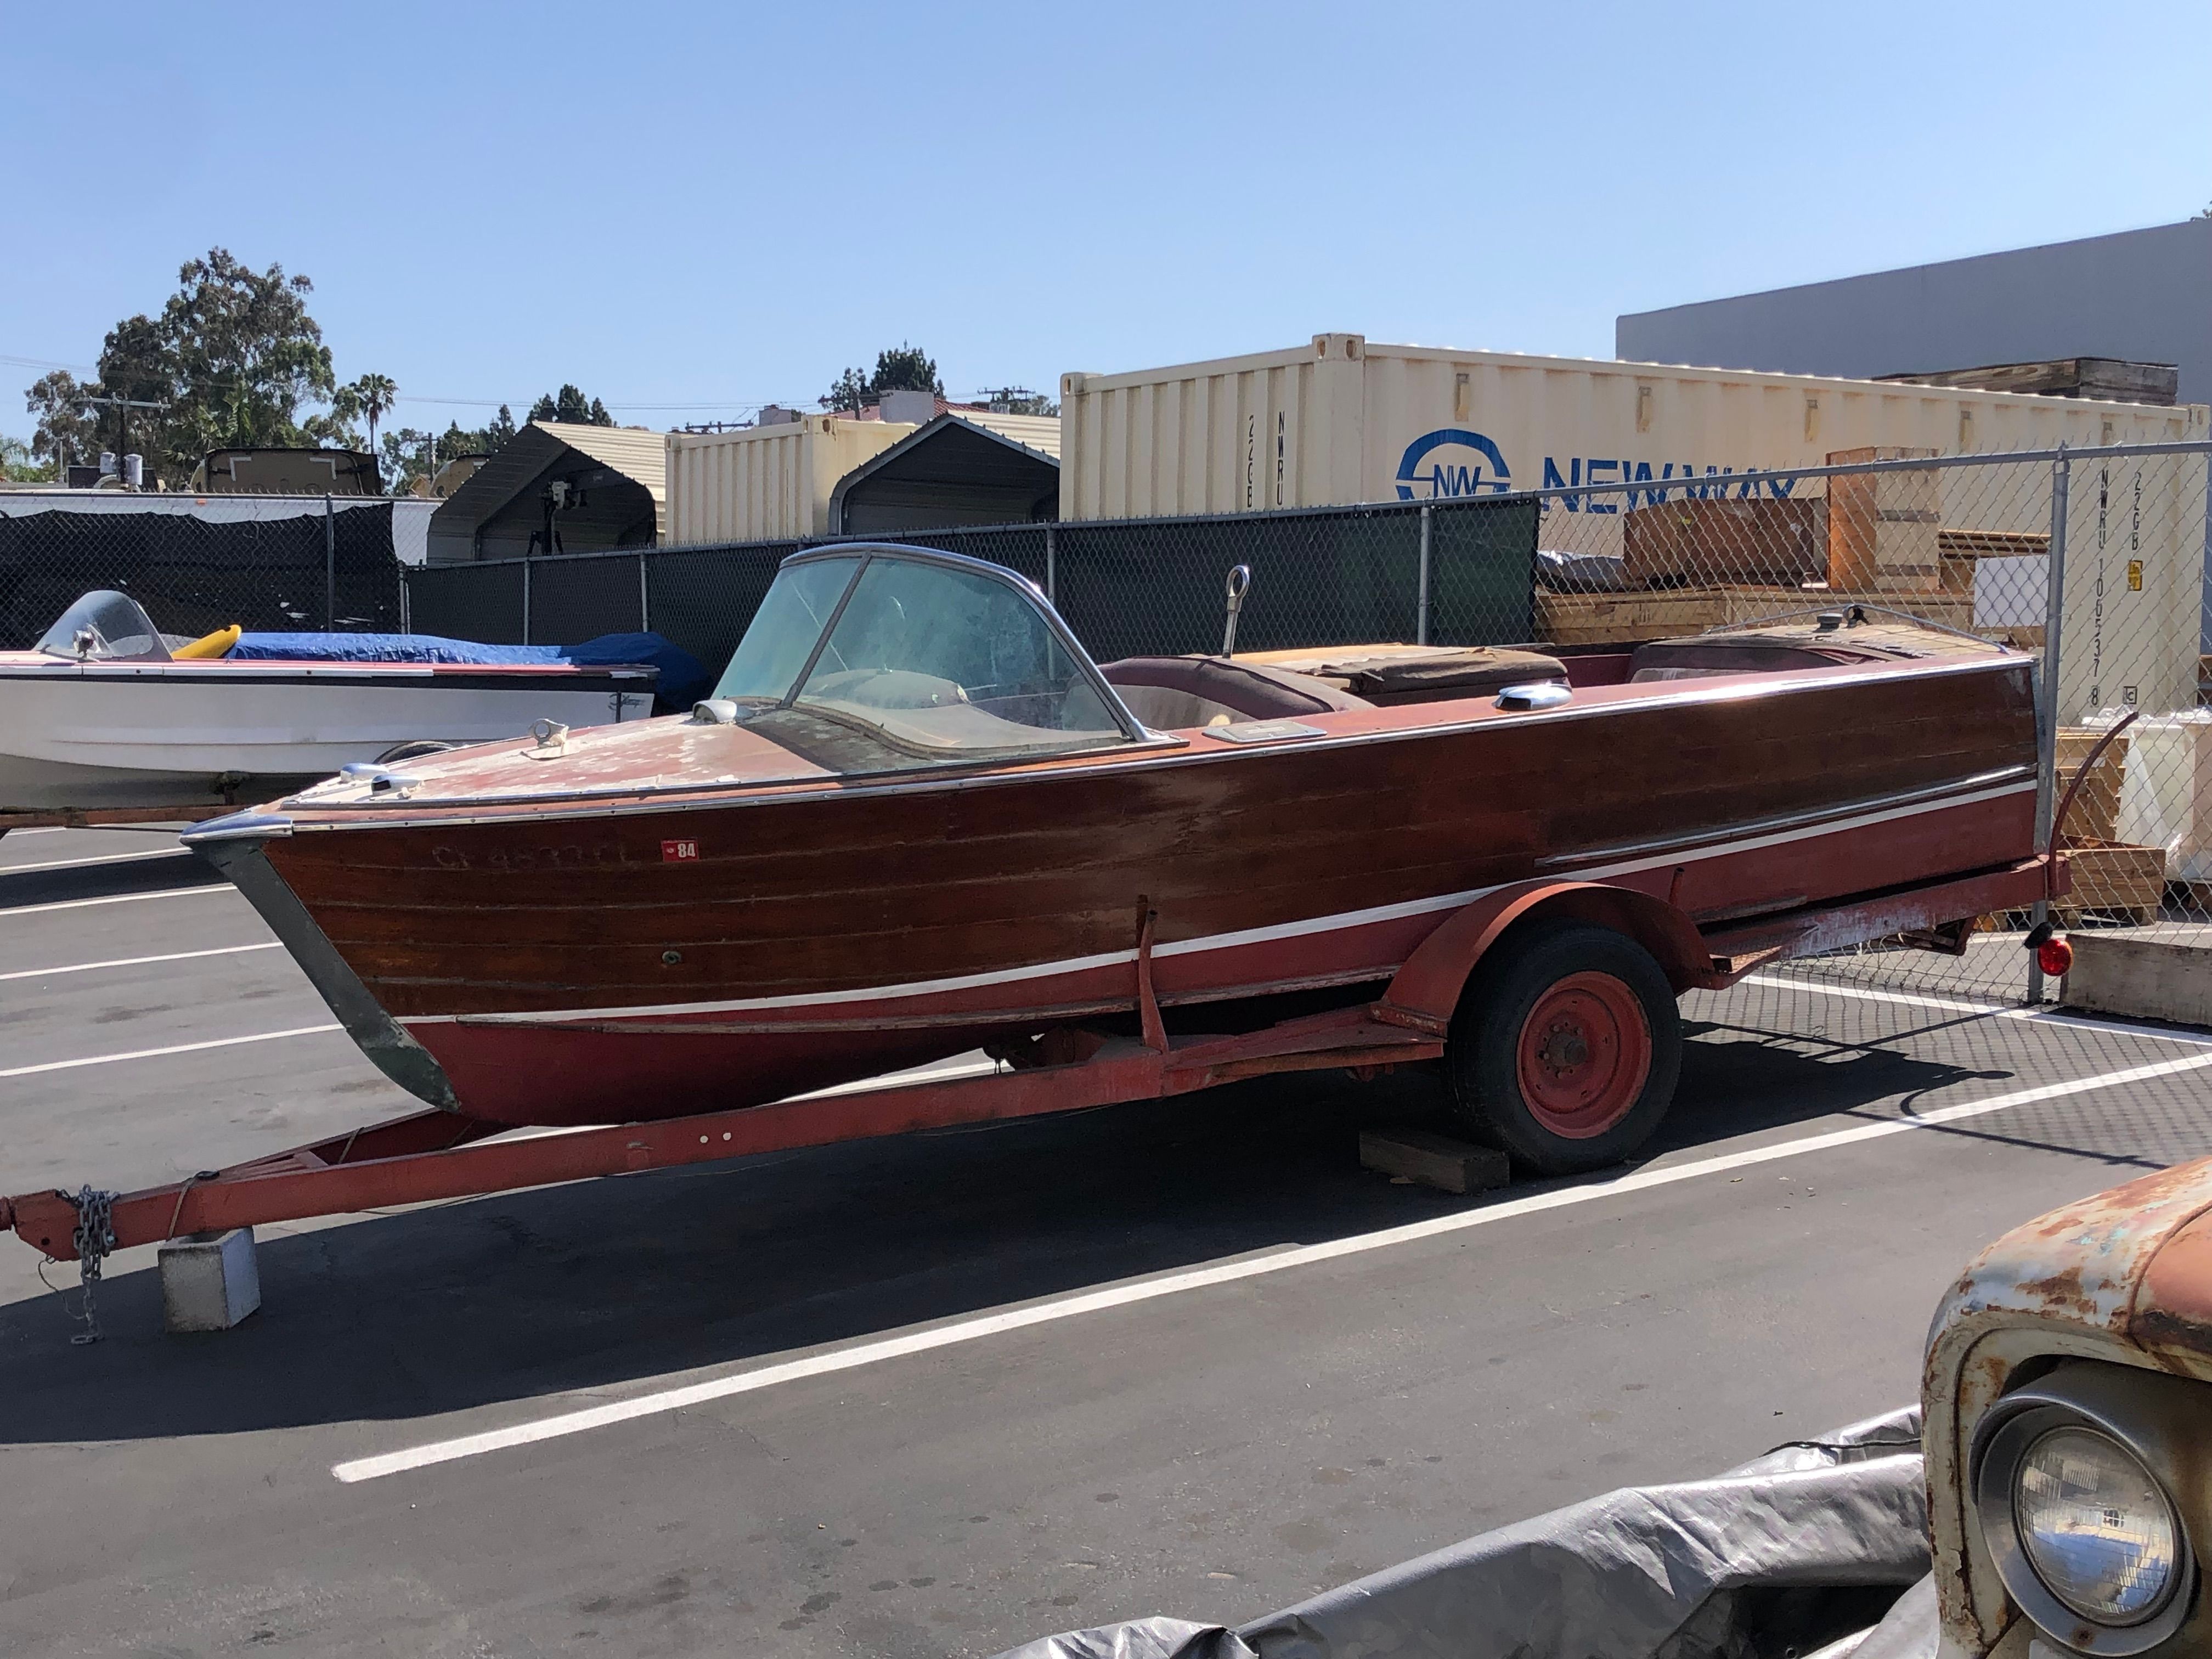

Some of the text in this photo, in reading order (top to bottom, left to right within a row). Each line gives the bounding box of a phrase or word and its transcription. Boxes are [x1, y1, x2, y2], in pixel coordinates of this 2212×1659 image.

[1277, 410, 1285, 506] NWRU
[1434, 464, 1482, 499] NW
[2099, 469, 2109, 549] NWRU
[2132, 472, 2142, 551] 22GB
[2091, 687, 2099, 706] 8
[677, 843, 696, 858] 84
